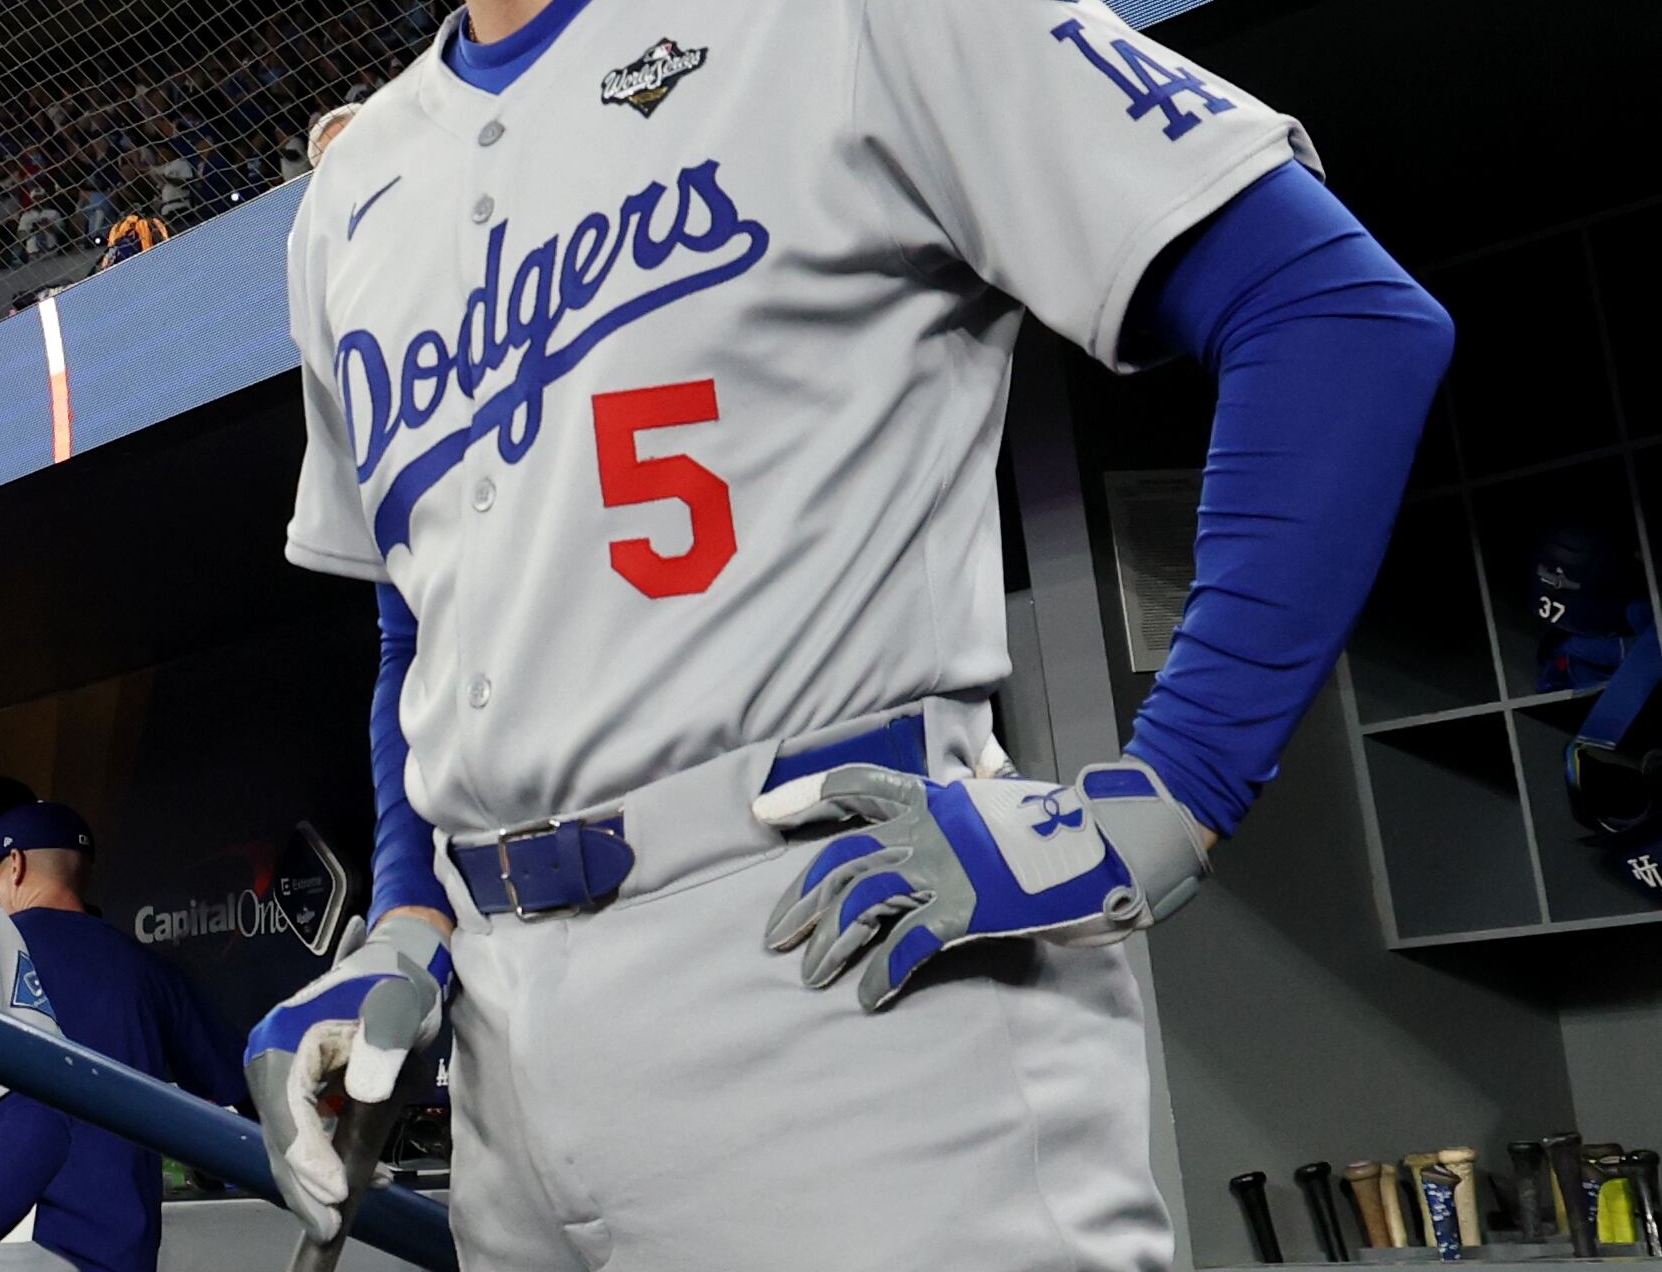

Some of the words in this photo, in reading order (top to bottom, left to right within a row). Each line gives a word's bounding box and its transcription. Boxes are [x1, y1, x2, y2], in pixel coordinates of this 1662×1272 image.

[1049, 18, 1237, 142] LA
[333, 159, 770, 560] Dodgers
[591, 378, 737, 599] 5
[1538, 595, 1566, 624] 37
